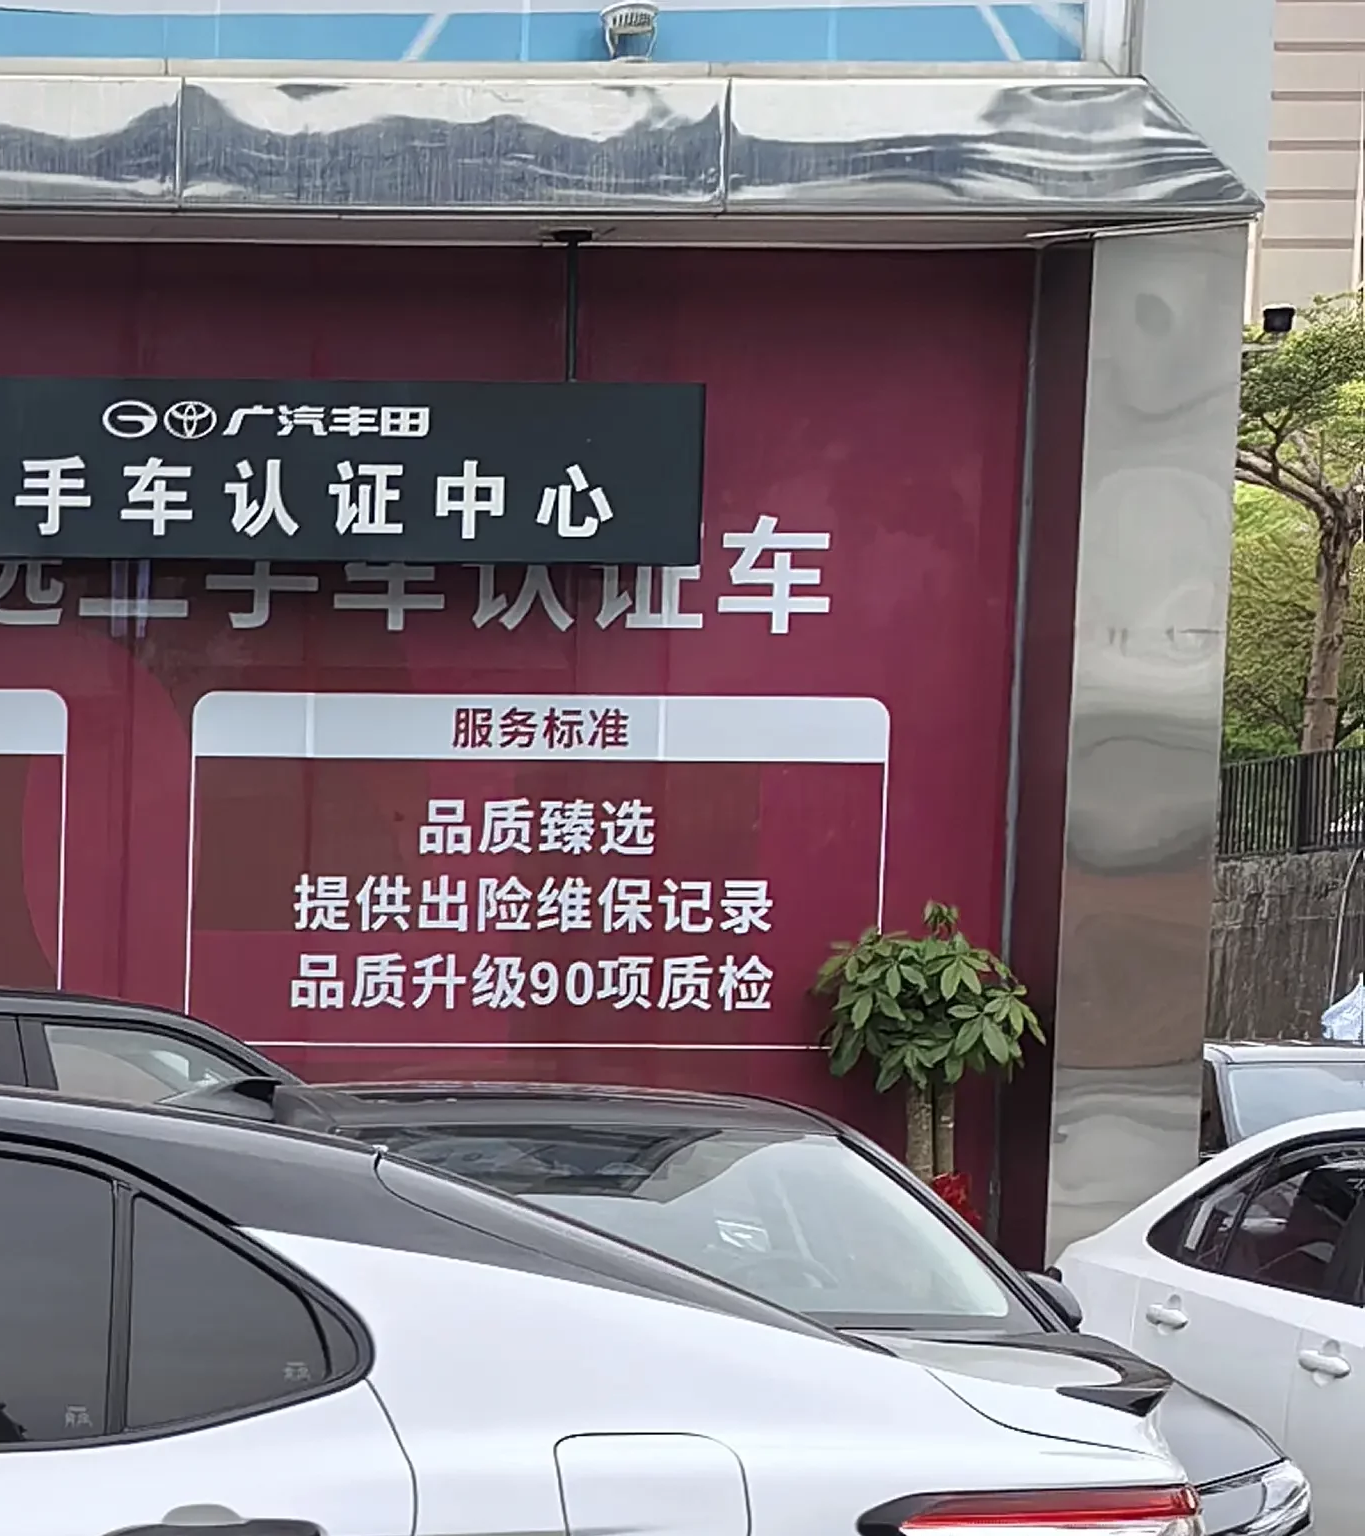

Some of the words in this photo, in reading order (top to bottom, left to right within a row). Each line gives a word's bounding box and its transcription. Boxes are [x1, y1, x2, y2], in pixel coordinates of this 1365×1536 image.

[222, 402, 430, 438] 广汽丰田
[450, 706, 630, 752] 服务标准
[416, 798, 657, 856] 品质臻选
[292, 873, 775, 936] 提供出险维保记录
[288, 952, 775, 1012] 品质升级90项质检
